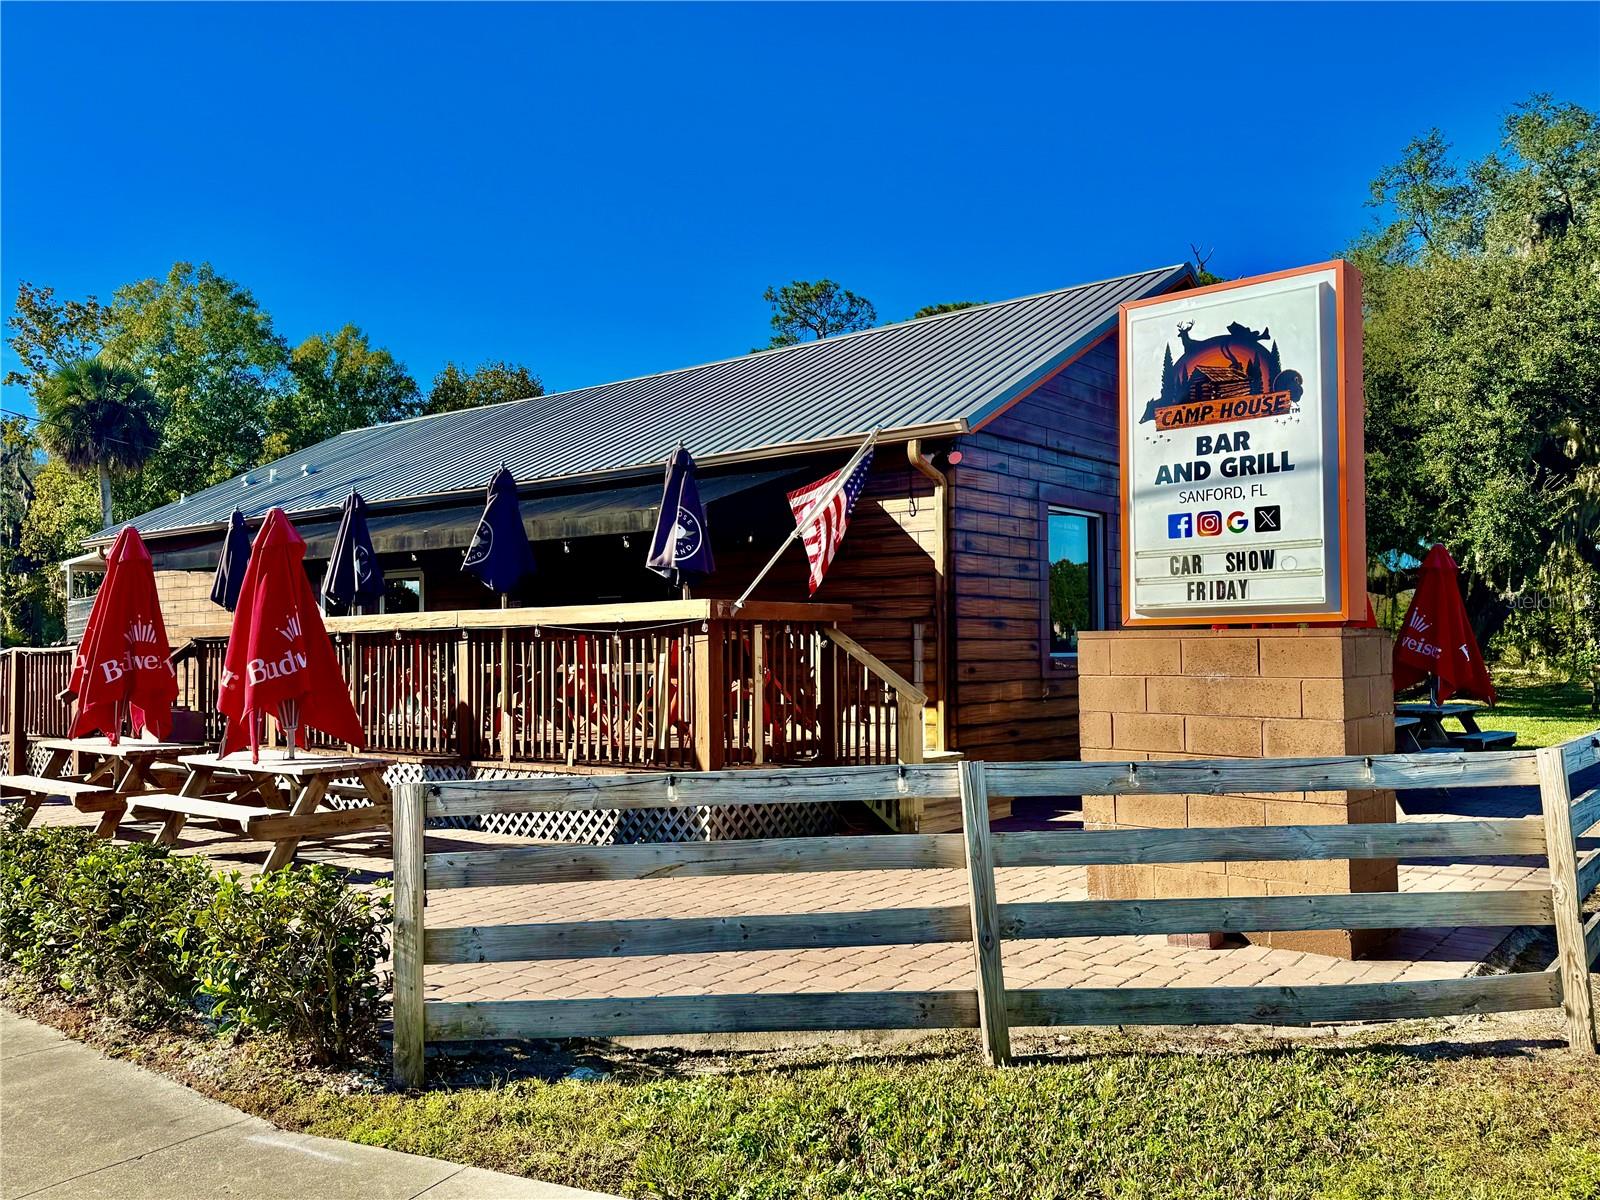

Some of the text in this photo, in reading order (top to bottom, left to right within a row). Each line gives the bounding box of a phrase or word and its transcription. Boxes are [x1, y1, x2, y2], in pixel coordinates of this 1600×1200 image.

[1161, 405, 1214, 427] CAMP
[1220, 394, 1288, 419] HOUSE
[1196, 430, 1251, 456] BAR
[1154, 450, 1296, 485] AND GRILL
[1179, 483, 1268, 504] SANFORD, FL
[1169, 549, 1275, 575] CAR SHOW
[1187, 579, 1248, 601] FRIDAY
